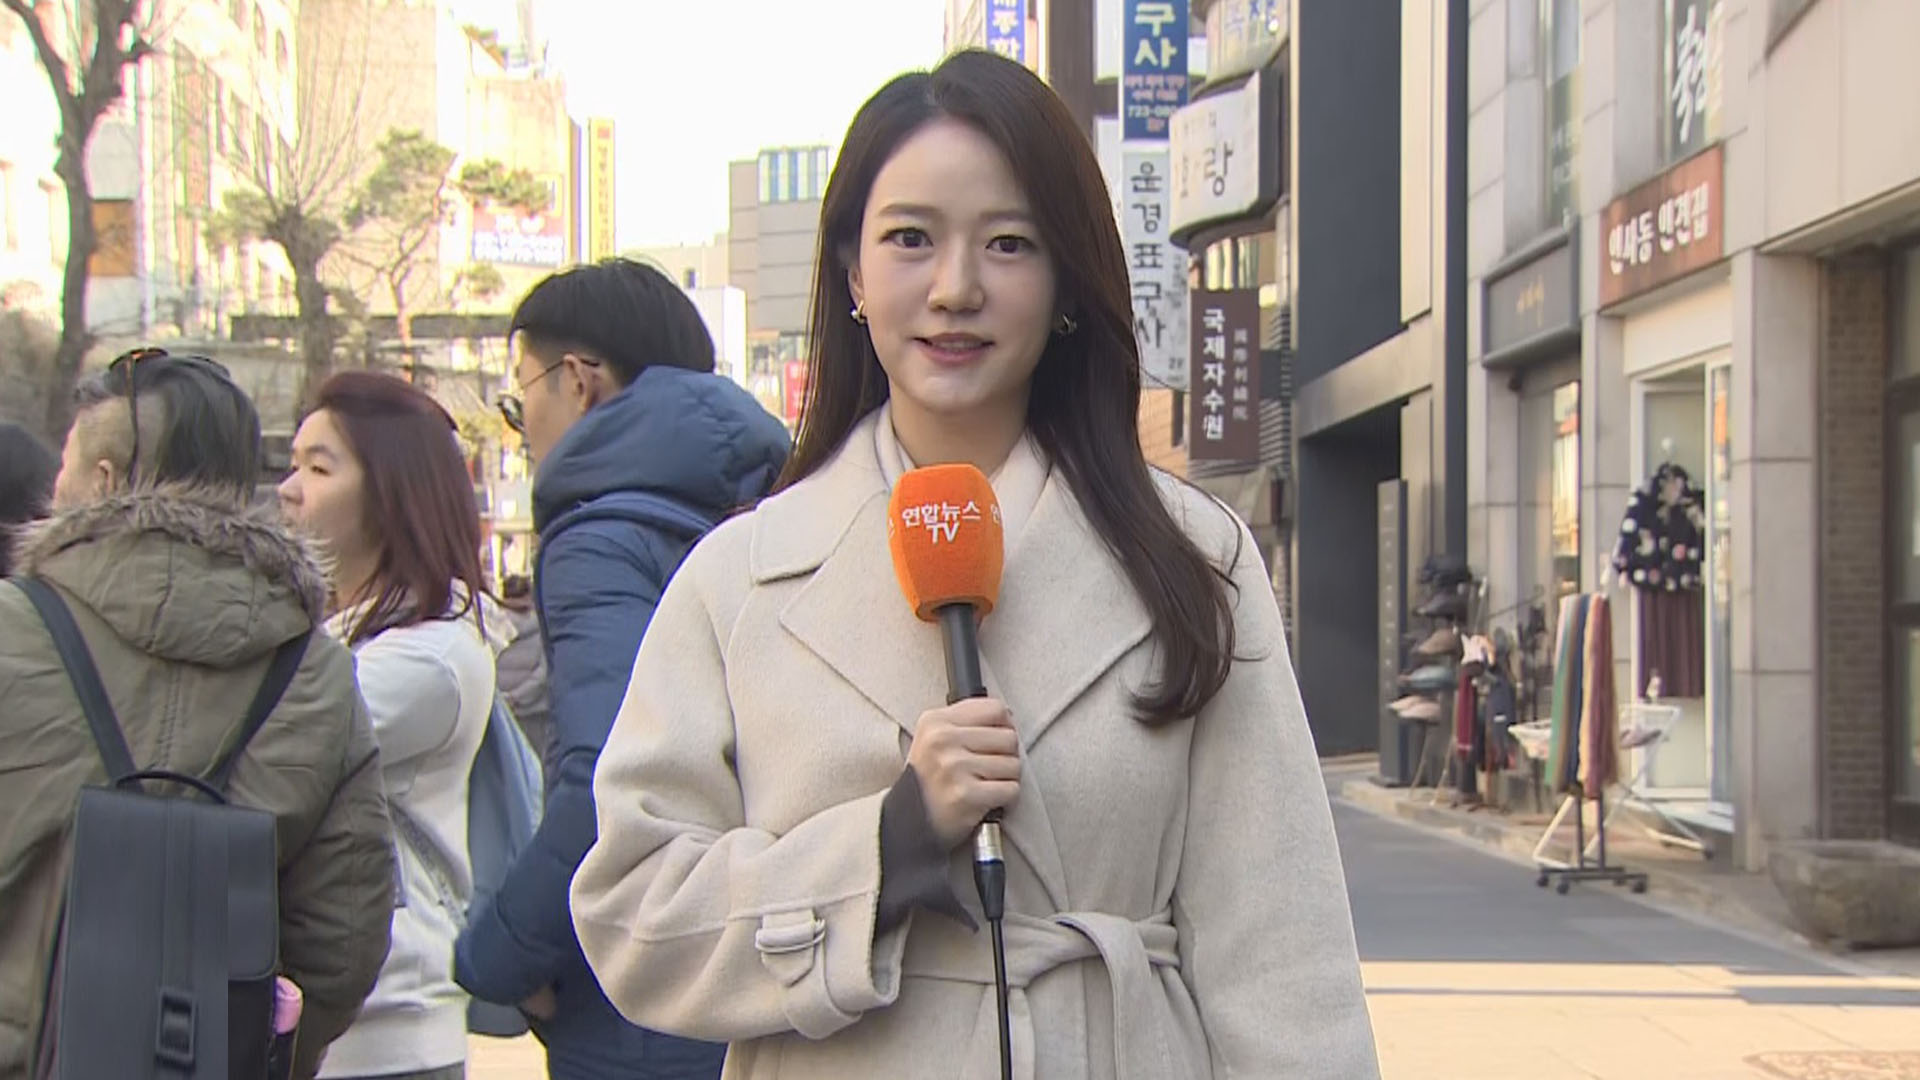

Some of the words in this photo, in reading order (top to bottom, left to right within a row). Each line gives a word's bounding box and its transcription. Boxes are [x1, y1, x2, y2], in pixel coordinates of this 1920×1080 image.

[1609, 209, 1654, 275] 인사동
[1203, 308, 1226, 440] 국제자수원
[902, 500, 981, 528] 연합뉴스
[926, 521, 960, 544] TV
